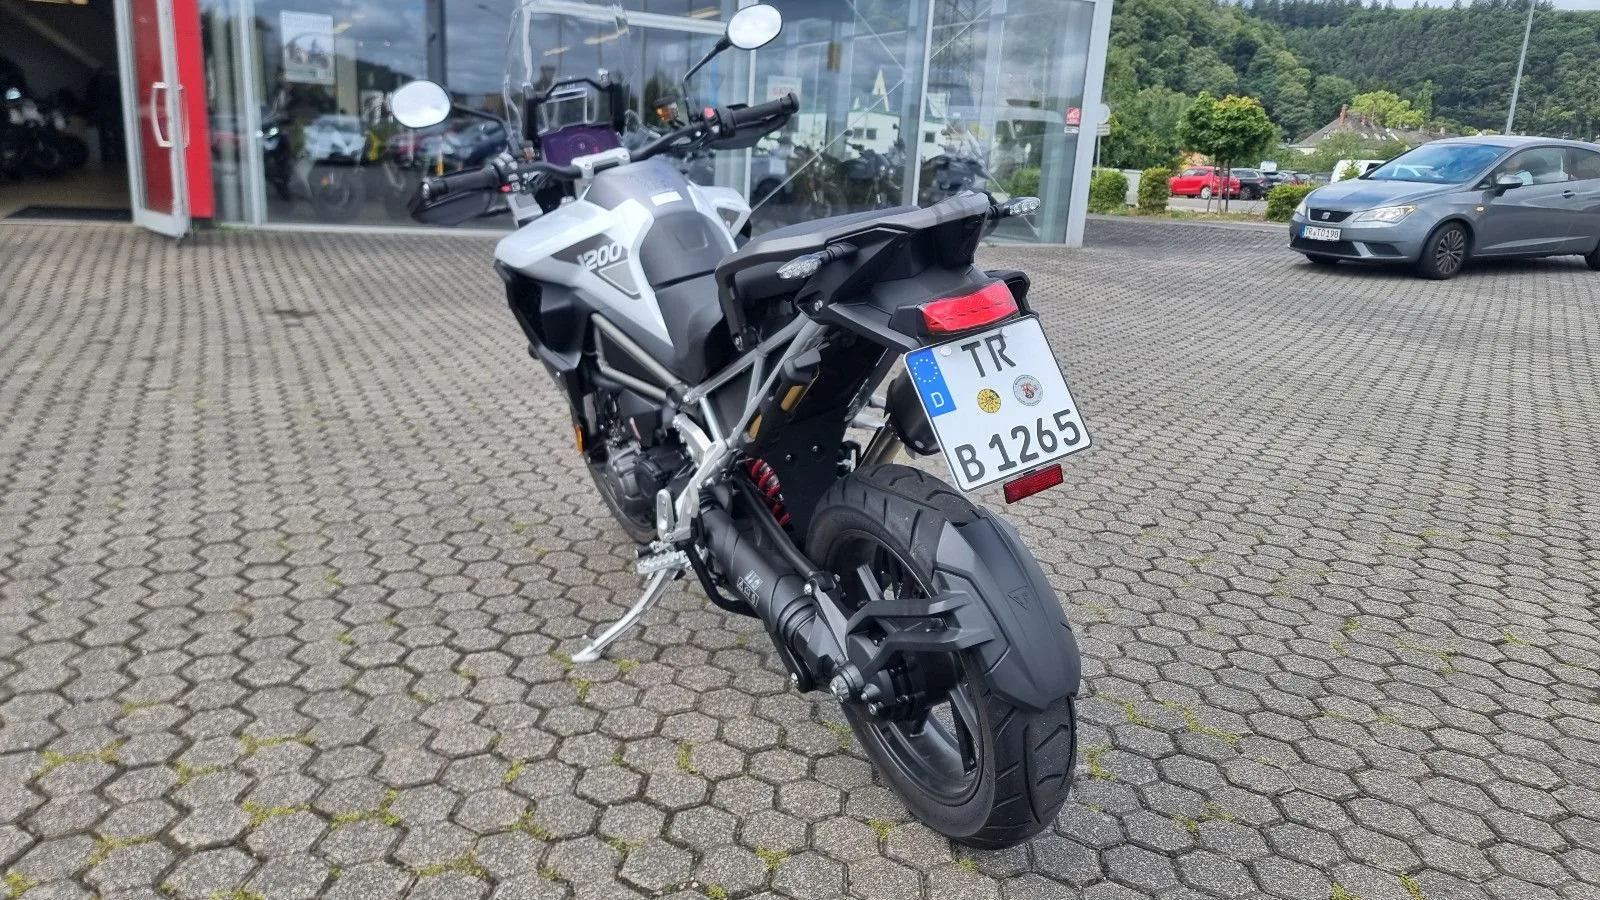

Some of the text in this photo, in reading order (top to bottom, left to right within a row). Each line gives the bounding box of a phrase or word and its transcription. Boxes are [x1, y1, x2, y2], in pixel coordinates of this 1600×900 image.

[576, 240, 623, 271] 1200
[961, 333, 1017, 378] TR
[930, 391, 945, 409] D
[954, 408, 1082, 483] B 1265
